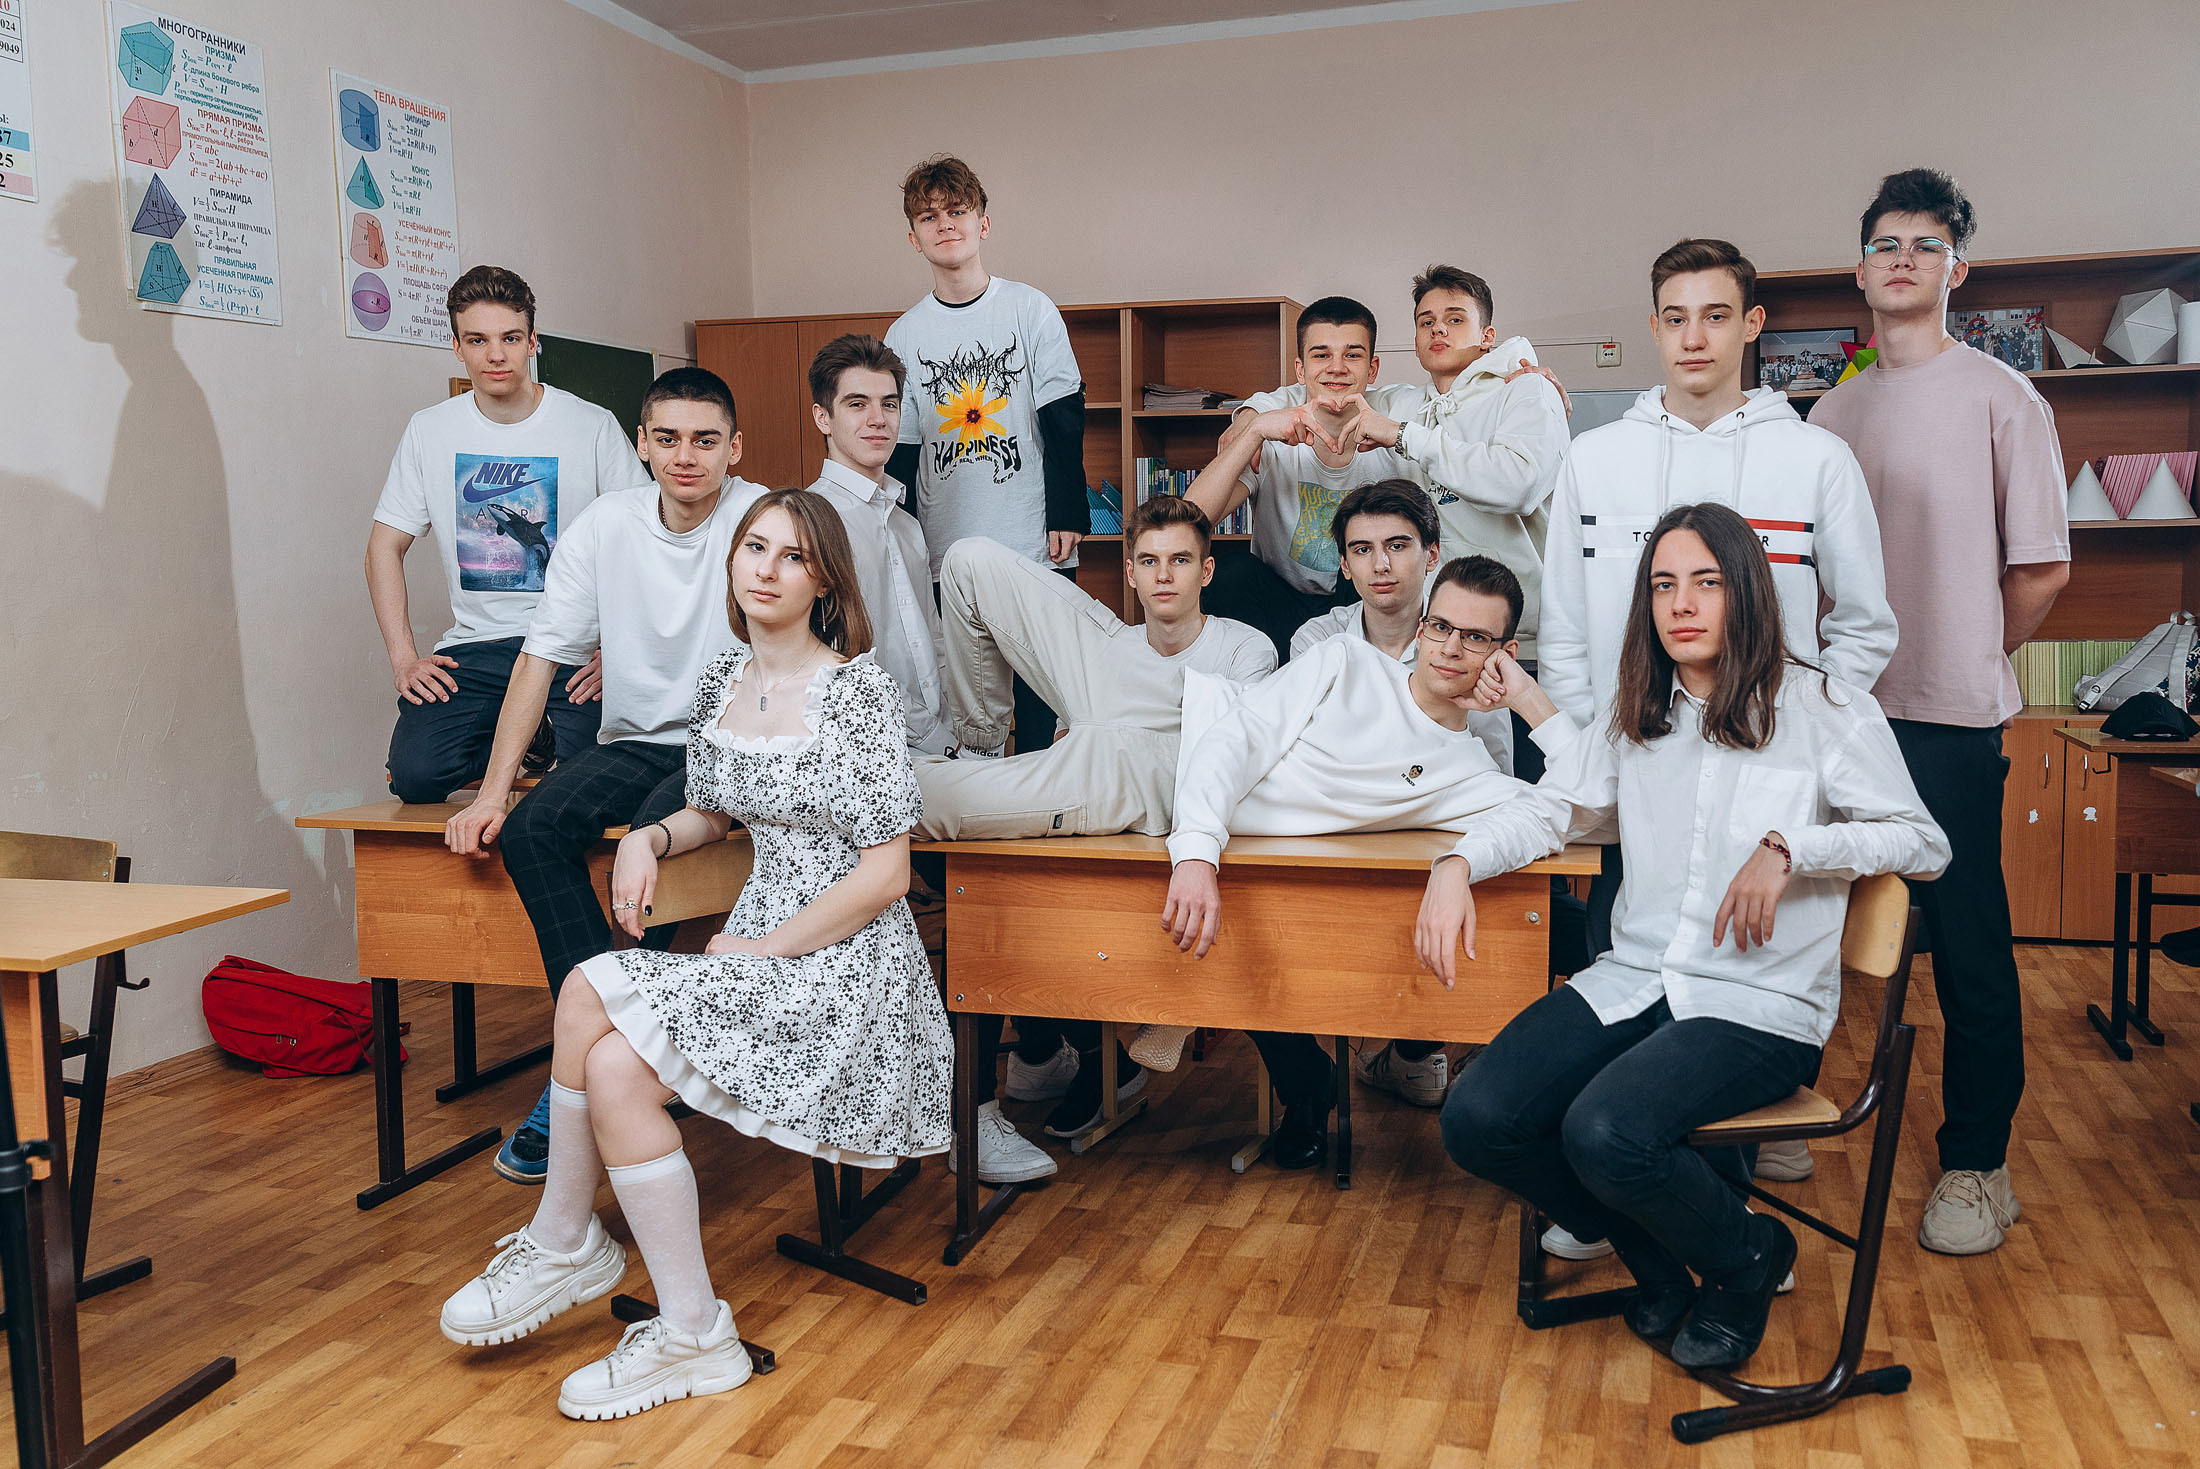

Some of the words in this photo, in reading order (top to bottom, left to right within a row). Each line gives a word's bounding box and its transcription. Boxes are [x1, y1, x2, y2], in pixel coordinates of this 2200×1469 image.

[158, 17, 246, 55] МНОГОГРАННИКИ
[204, 45, 237, 63] ПРИЗМА
[211, 72, 241, 88] бокового
[241, 82, 260, 94] ребра
[373, 89, 397, 106] ТЕЛА
[399, 98, 446, 122] ВРАЩЕНИЯ
[197, 108, 231, 126] ПРЯМАЯ
[232, 118, 264, 135] ПРИЗМА
[204, 145, 220, 157] abc
[412, 165, 430, 177] КОНУС
[209, 187, 253, 205] ПИРАМИДА
[193, 212, 237, 228] ПРАВИЛЬНАЯ
[236, 221, 272, 236] ПИРАМИДА
[433, 227, 451, 238] КОНУС
[214, 255, 257, 271] ПРАВИЛЬНАЯ
[196, 264, 236, 278] УСЕЧЕННАЯ
[236, 271, 274, 285] ПИРАМИДА
[403, 277, 431, 290] ПЛОЩАДЬ
[411, 315, 432, 325] ОБЪЕМ
[432, 316, 448, 327] ШАРА
[930, 434, 1021, 474] HAPPINESS
[974, 454, 993, 463] WHEN
[474, 462, 531, 486] NIKE
[1298, 482, 1337, 512] MUSIC
[964, 744, 999, 758] adidas
